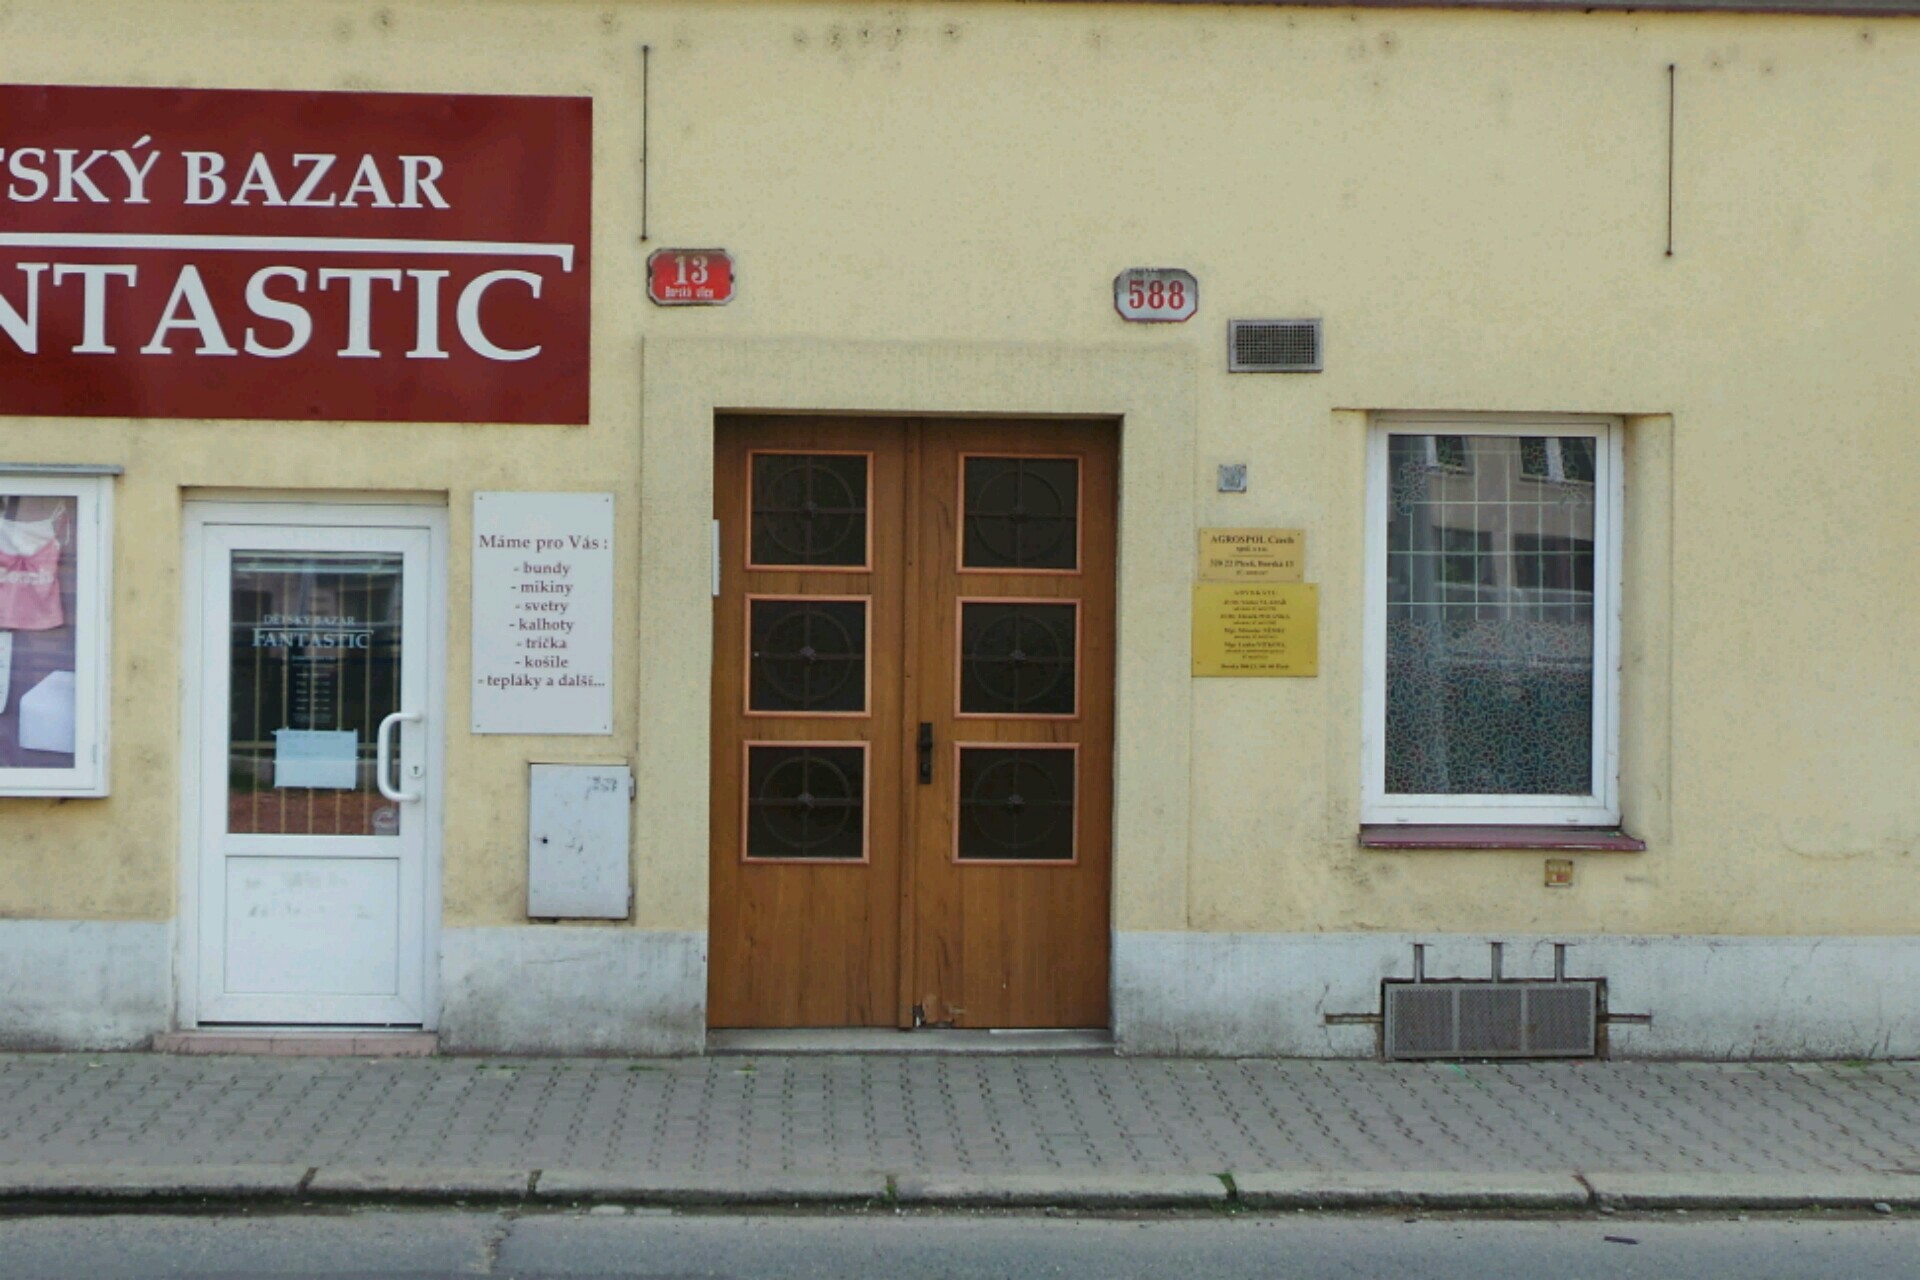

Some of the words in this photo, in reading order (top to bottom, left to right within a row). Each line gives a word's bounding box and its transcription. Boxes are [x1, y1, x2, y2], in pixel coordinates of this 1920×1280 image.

[0, 134, 160, 203] SKÝ
[180, 151, 450, 209] BAZAR
[673, 255, 708, 285] 13
[1129, 280, 1185, 310] 588
[479, 535, 531, 549] Máme
[536, 537, 564, 553] pro
[569, 534, 600, 549] Vás
[523, 561, 571, 577] bundy
[520, 580, 573, 597] mikiny
[525, 600, 569, 615] svetry
[518, 618, 574, 634] kalhoty
[252, 627, 371, 649] FANTASTIC
[525, 655, 569, 668] košile
[487, 673, 542, 690] tepláky
[546, 678, 554, 687] a
